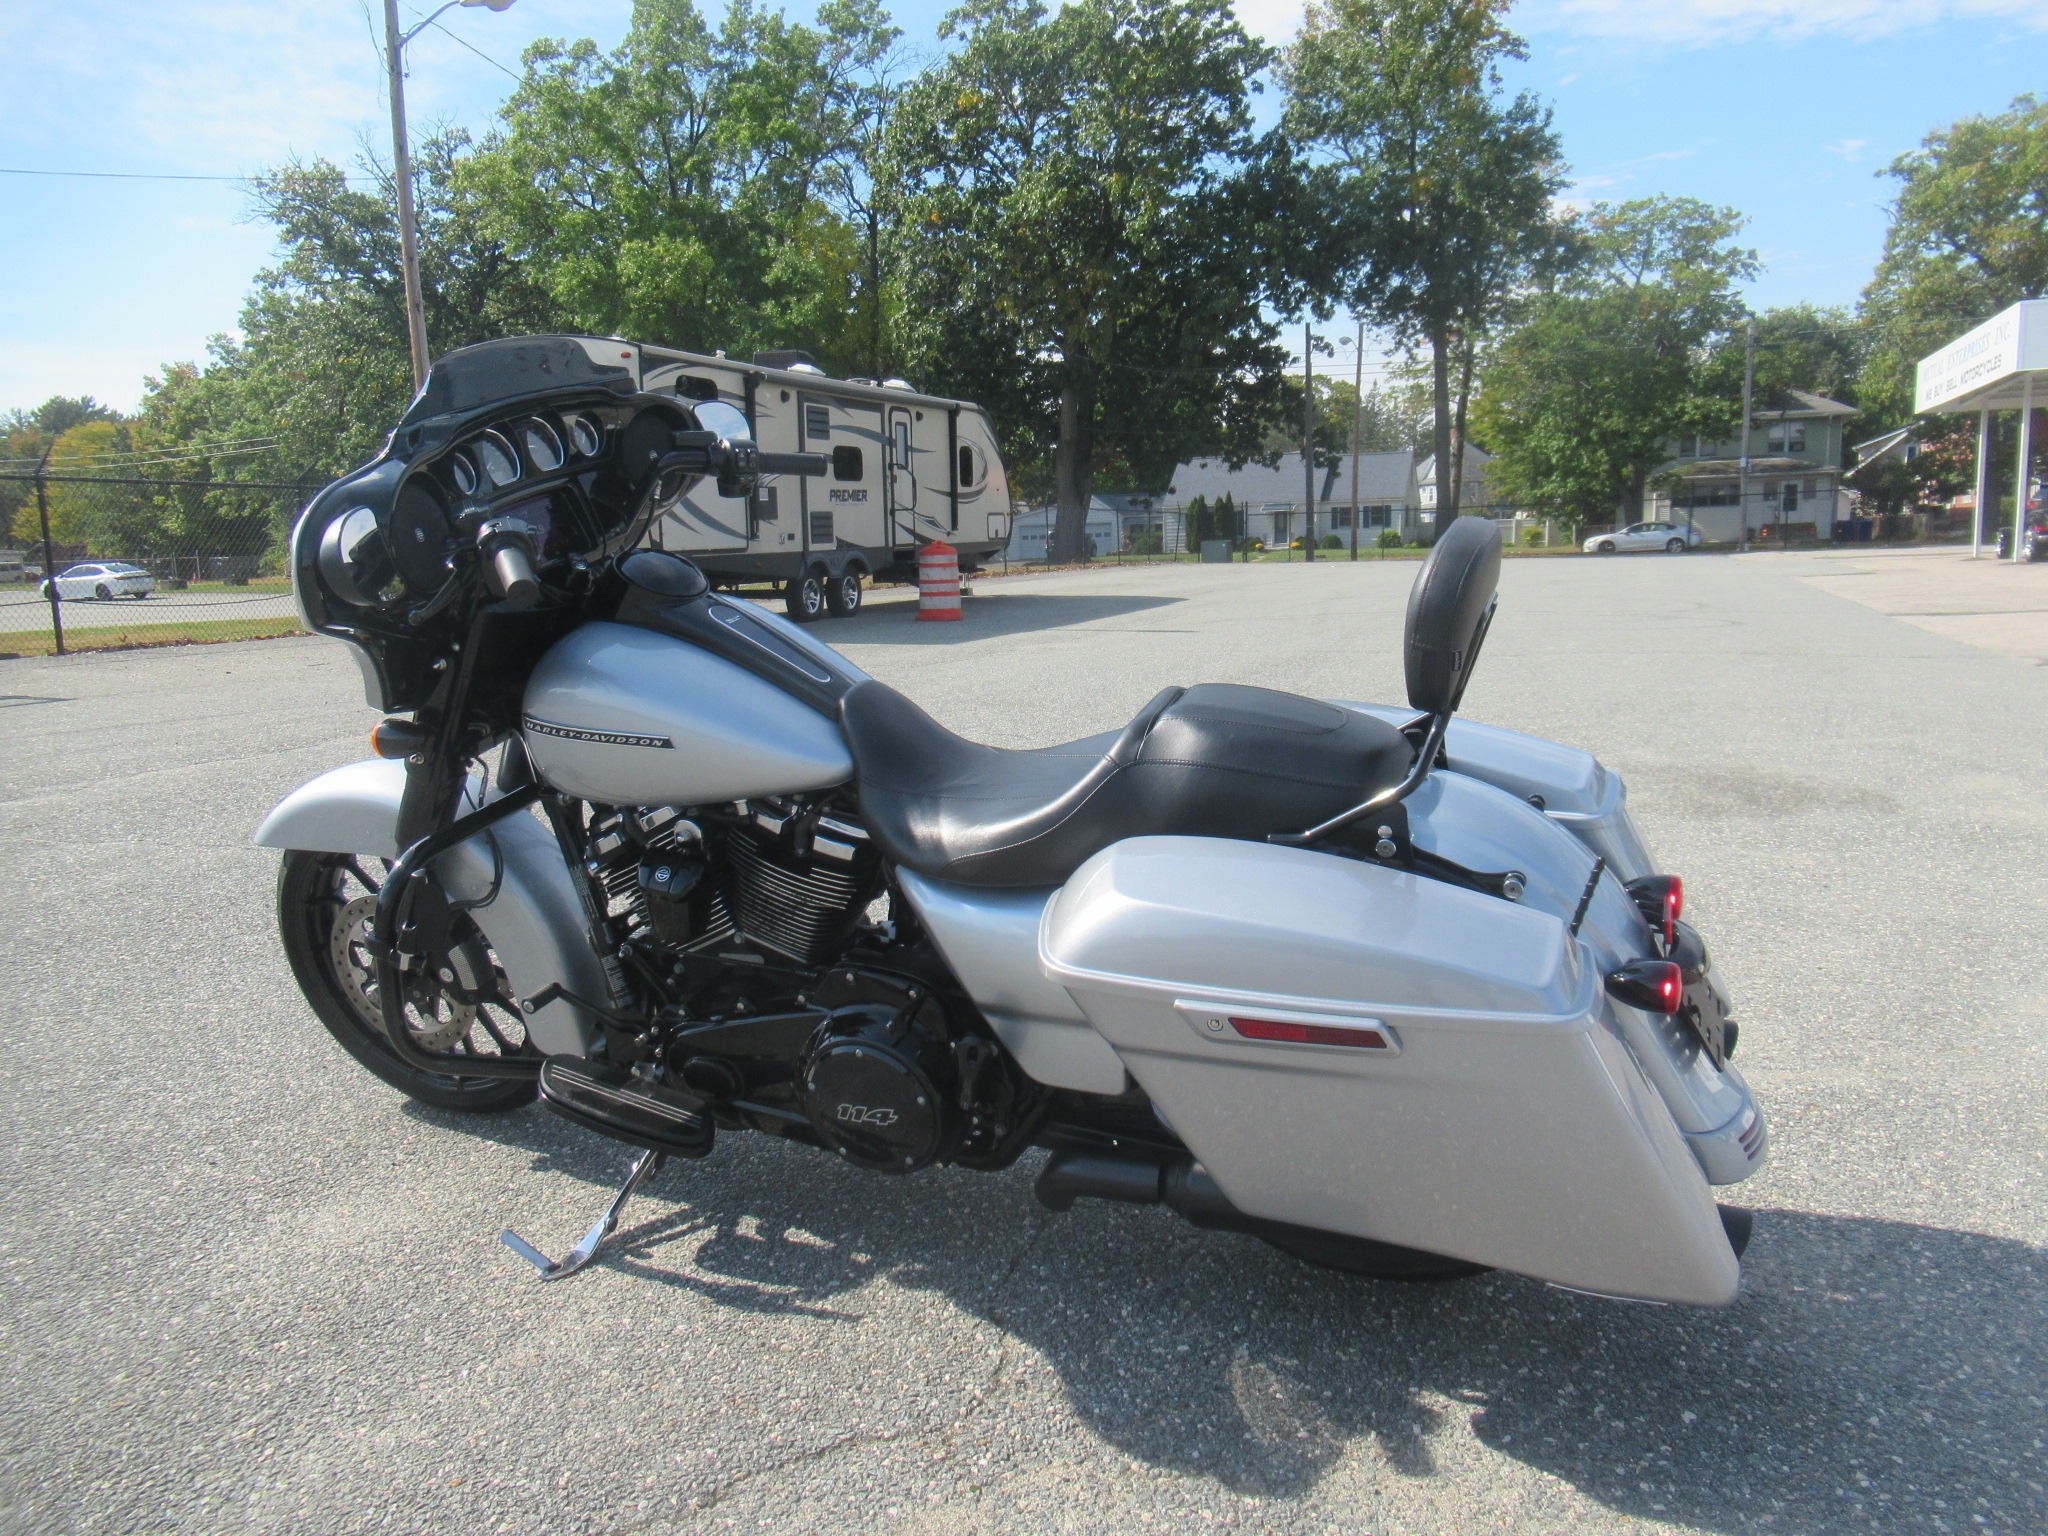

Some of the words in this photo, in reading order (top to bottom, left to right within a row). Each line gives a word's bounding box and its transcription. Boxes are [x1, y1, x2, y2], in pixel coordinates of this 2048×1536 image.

[1947, 331, 1991, 372] ENTERPRISES
[1934, 383, 1944, 398] BUY
[1946, 375, 1958, 393] SELL
[1960, 353, 2002, 385] MOTORCYCLES
[829, 489, 868, 502] PREMIER
[526, 721, 664, 747] HARLEY-DAVIDSON
[836, 1103, 898, 1126] 114
